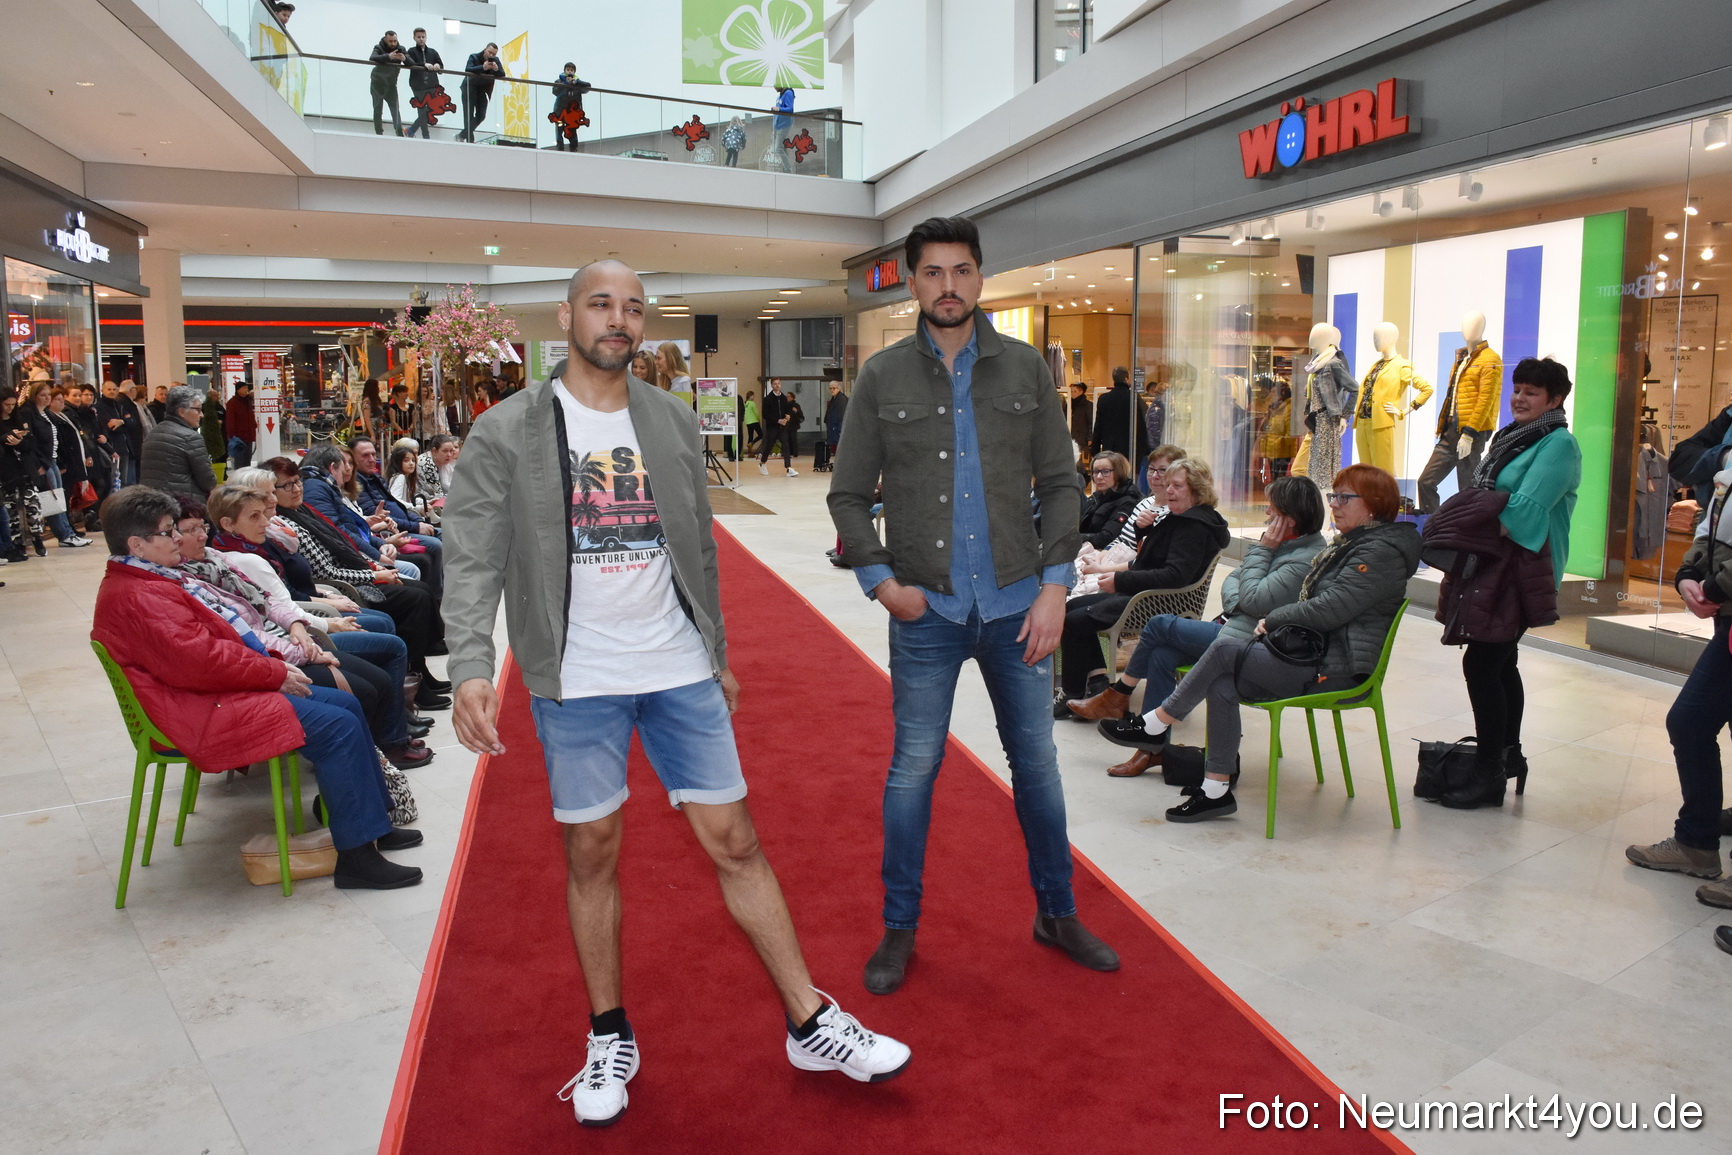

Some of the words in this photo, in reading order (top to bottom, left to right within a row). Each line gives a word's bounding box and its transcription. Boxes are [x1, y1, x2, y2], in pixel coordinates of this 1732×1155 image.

[1238, 77, 1409, 179] WÖHRL
[865, 259, 899, 292] WÖHRL
[600, 566, 623, 574] EST.
